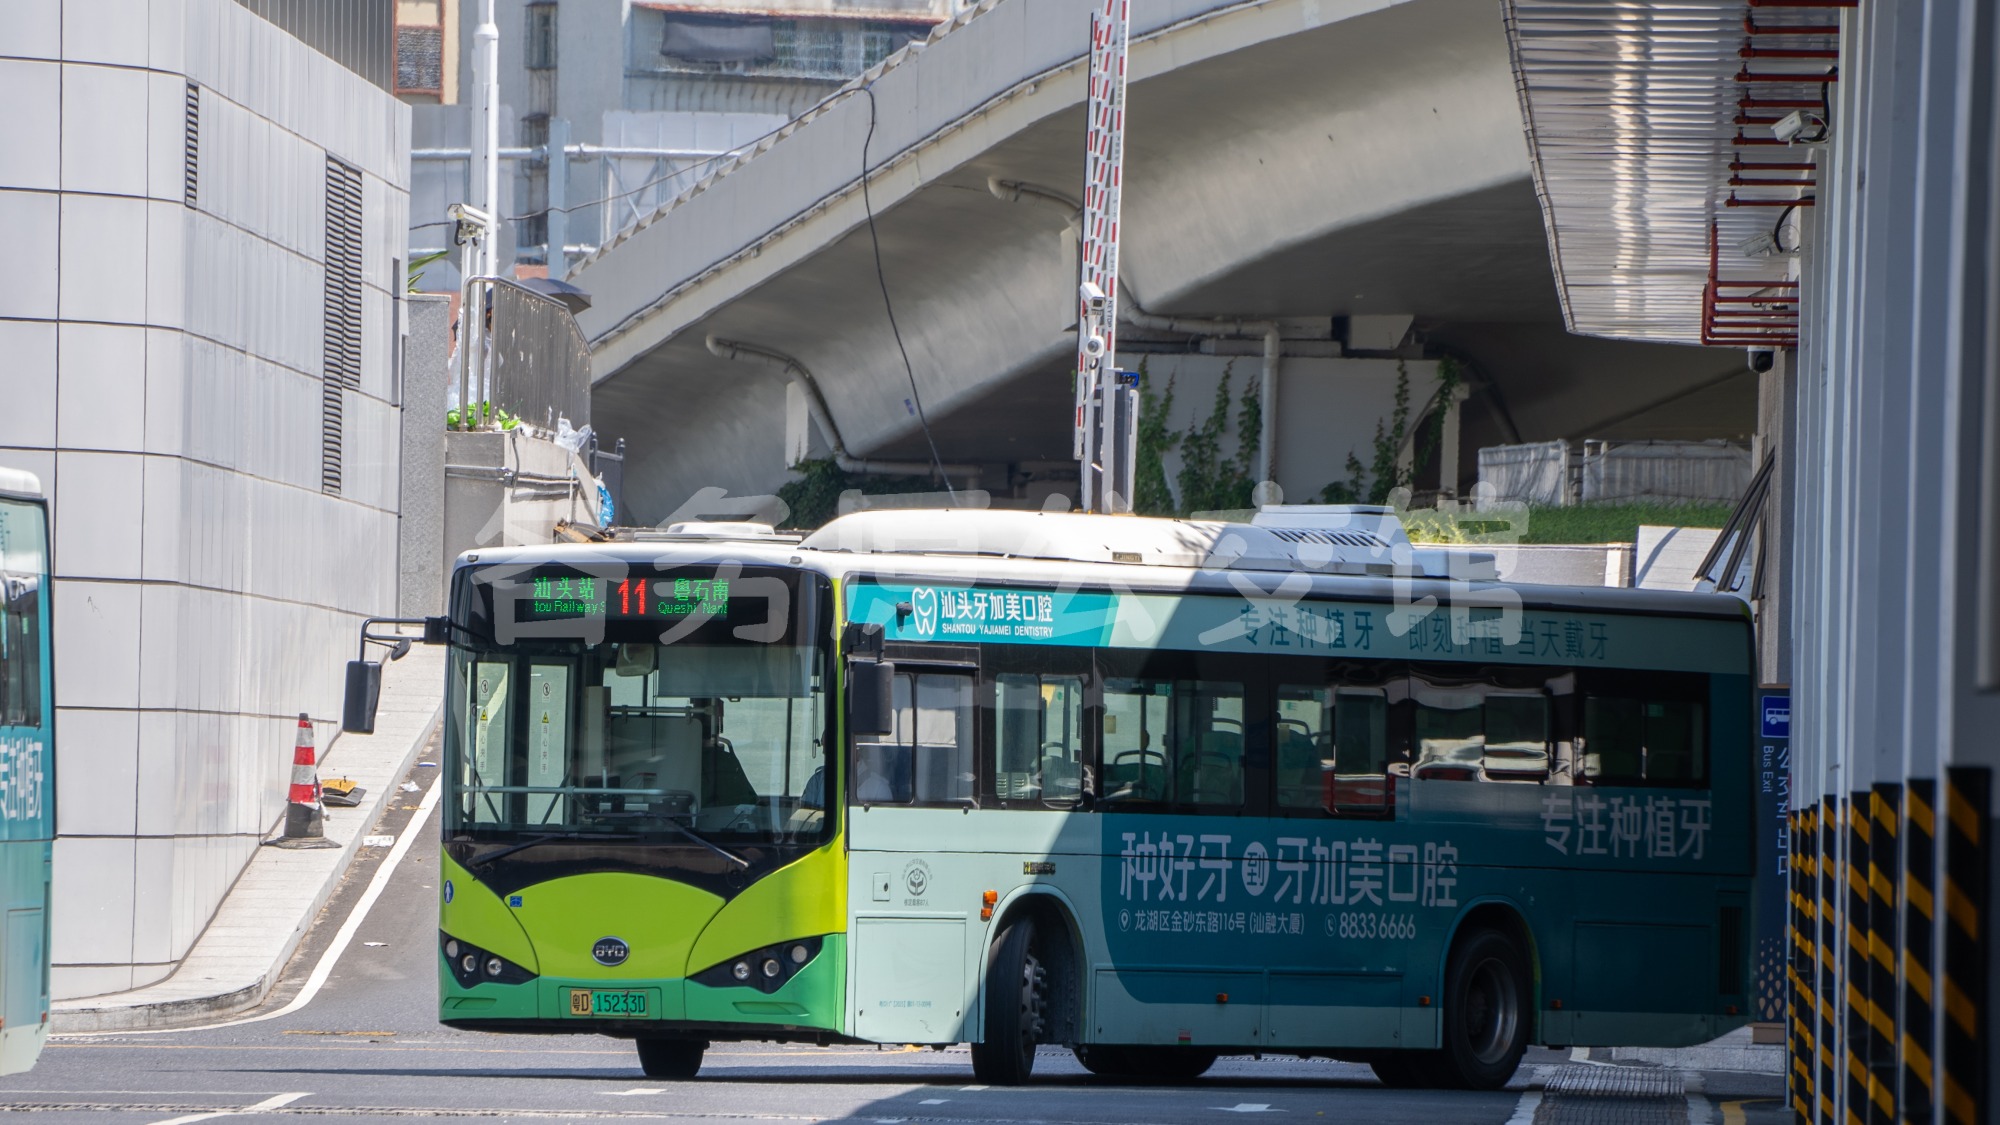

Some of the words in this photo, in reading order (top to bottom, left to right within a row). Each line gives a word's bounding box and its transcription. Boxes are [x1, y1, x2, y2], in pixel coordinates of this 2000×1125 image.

[533, 577, 595, 600] 汕头站
[617, 578, 646, 615] 11
[554, 601, 598, 615] Railway
[658, 602, 697, 614] Queshi
[940, 591, 1054, 622] 汕头牙加美口腔
[942, 623, 976, 634] SHANTOU
[979, 625, 1011, 635] YAJIAMEI
[1014, 626, 1053, 637] DENTISTRY
[1240, 604, 1373, 650] 专注种植牙
[1408, 614, 1502, 656] 即刻种植
[1517, 617, 1609, 660] 当天戴牙
[1763, 745, 1774, 768] Bus
[1763, 771, 1773, 792] Exit
[1541, 793, 1711, 860] 专注种植牙
[1135, 910, 1246, 934] 龙湖区金砂东路116号
